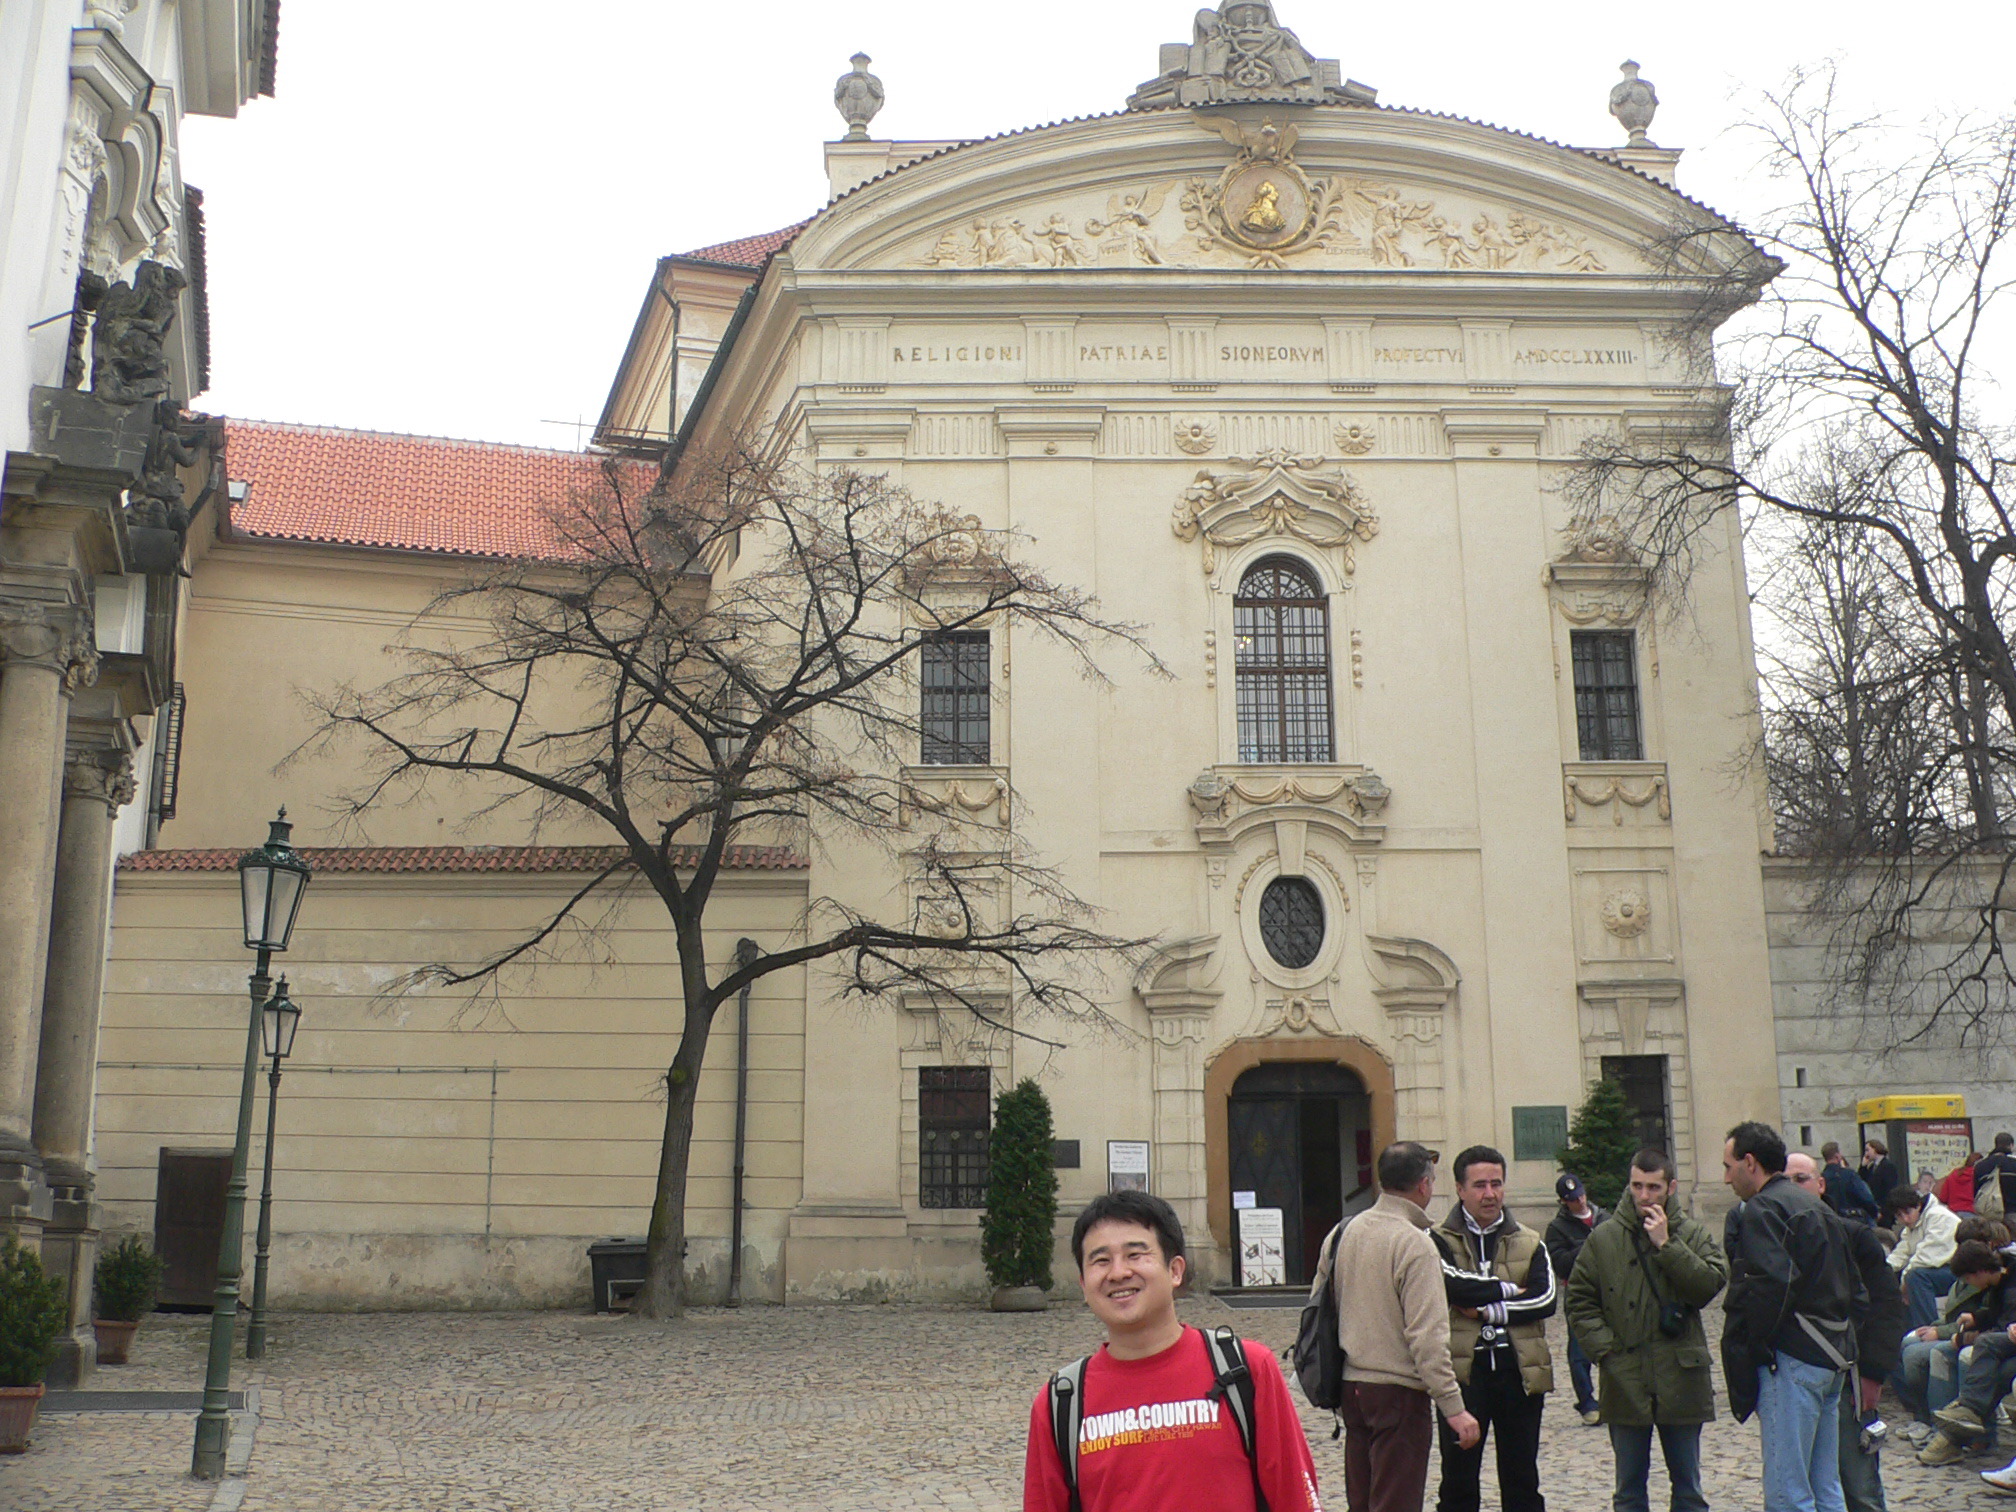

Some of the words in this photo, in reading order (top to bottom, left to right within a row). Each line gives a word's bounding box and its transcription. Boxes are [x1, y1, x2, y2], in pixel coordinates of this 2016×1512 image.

[893, 346, 1022, 363] RELIGIONI
[1079, 346, 1168, 362] PATRIAE
[1220, 346, 1325, 362] SIONEORVM
[1373, 348, 1465, 364] PROFECTVI
[1079, 1437, 1113, 1455] ENJOY
[1113, 1430, 1145, 1446] SURF
